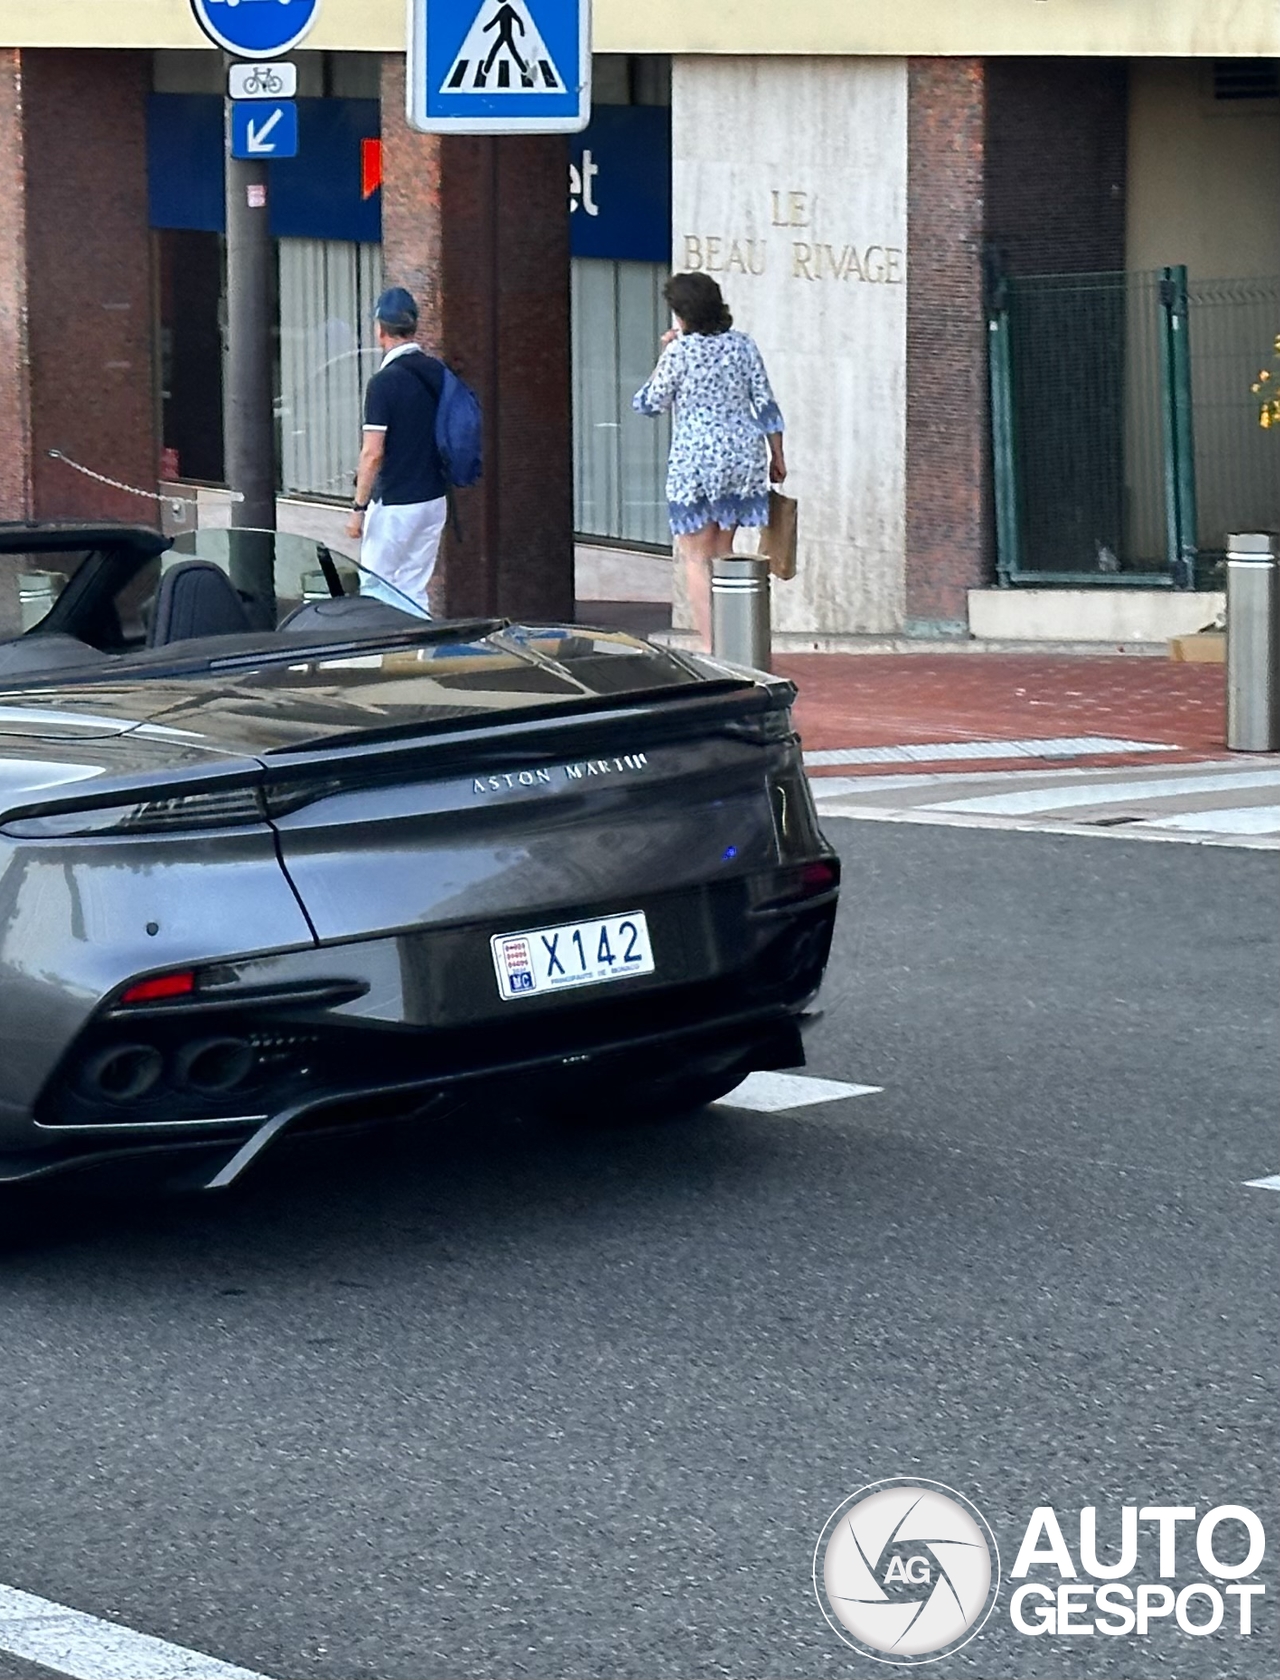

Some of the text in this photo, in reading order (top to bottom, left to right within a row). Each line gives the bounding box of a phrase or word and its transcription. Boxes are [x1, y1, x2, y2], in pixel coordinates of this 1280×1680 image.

[771, 189, 809, 228] LE
[684, 234, 903, 284] BEAU RIVAGE
[473, 753, 647, 794] ASTON MARTIN
[541, 921, 642, 977] X142
